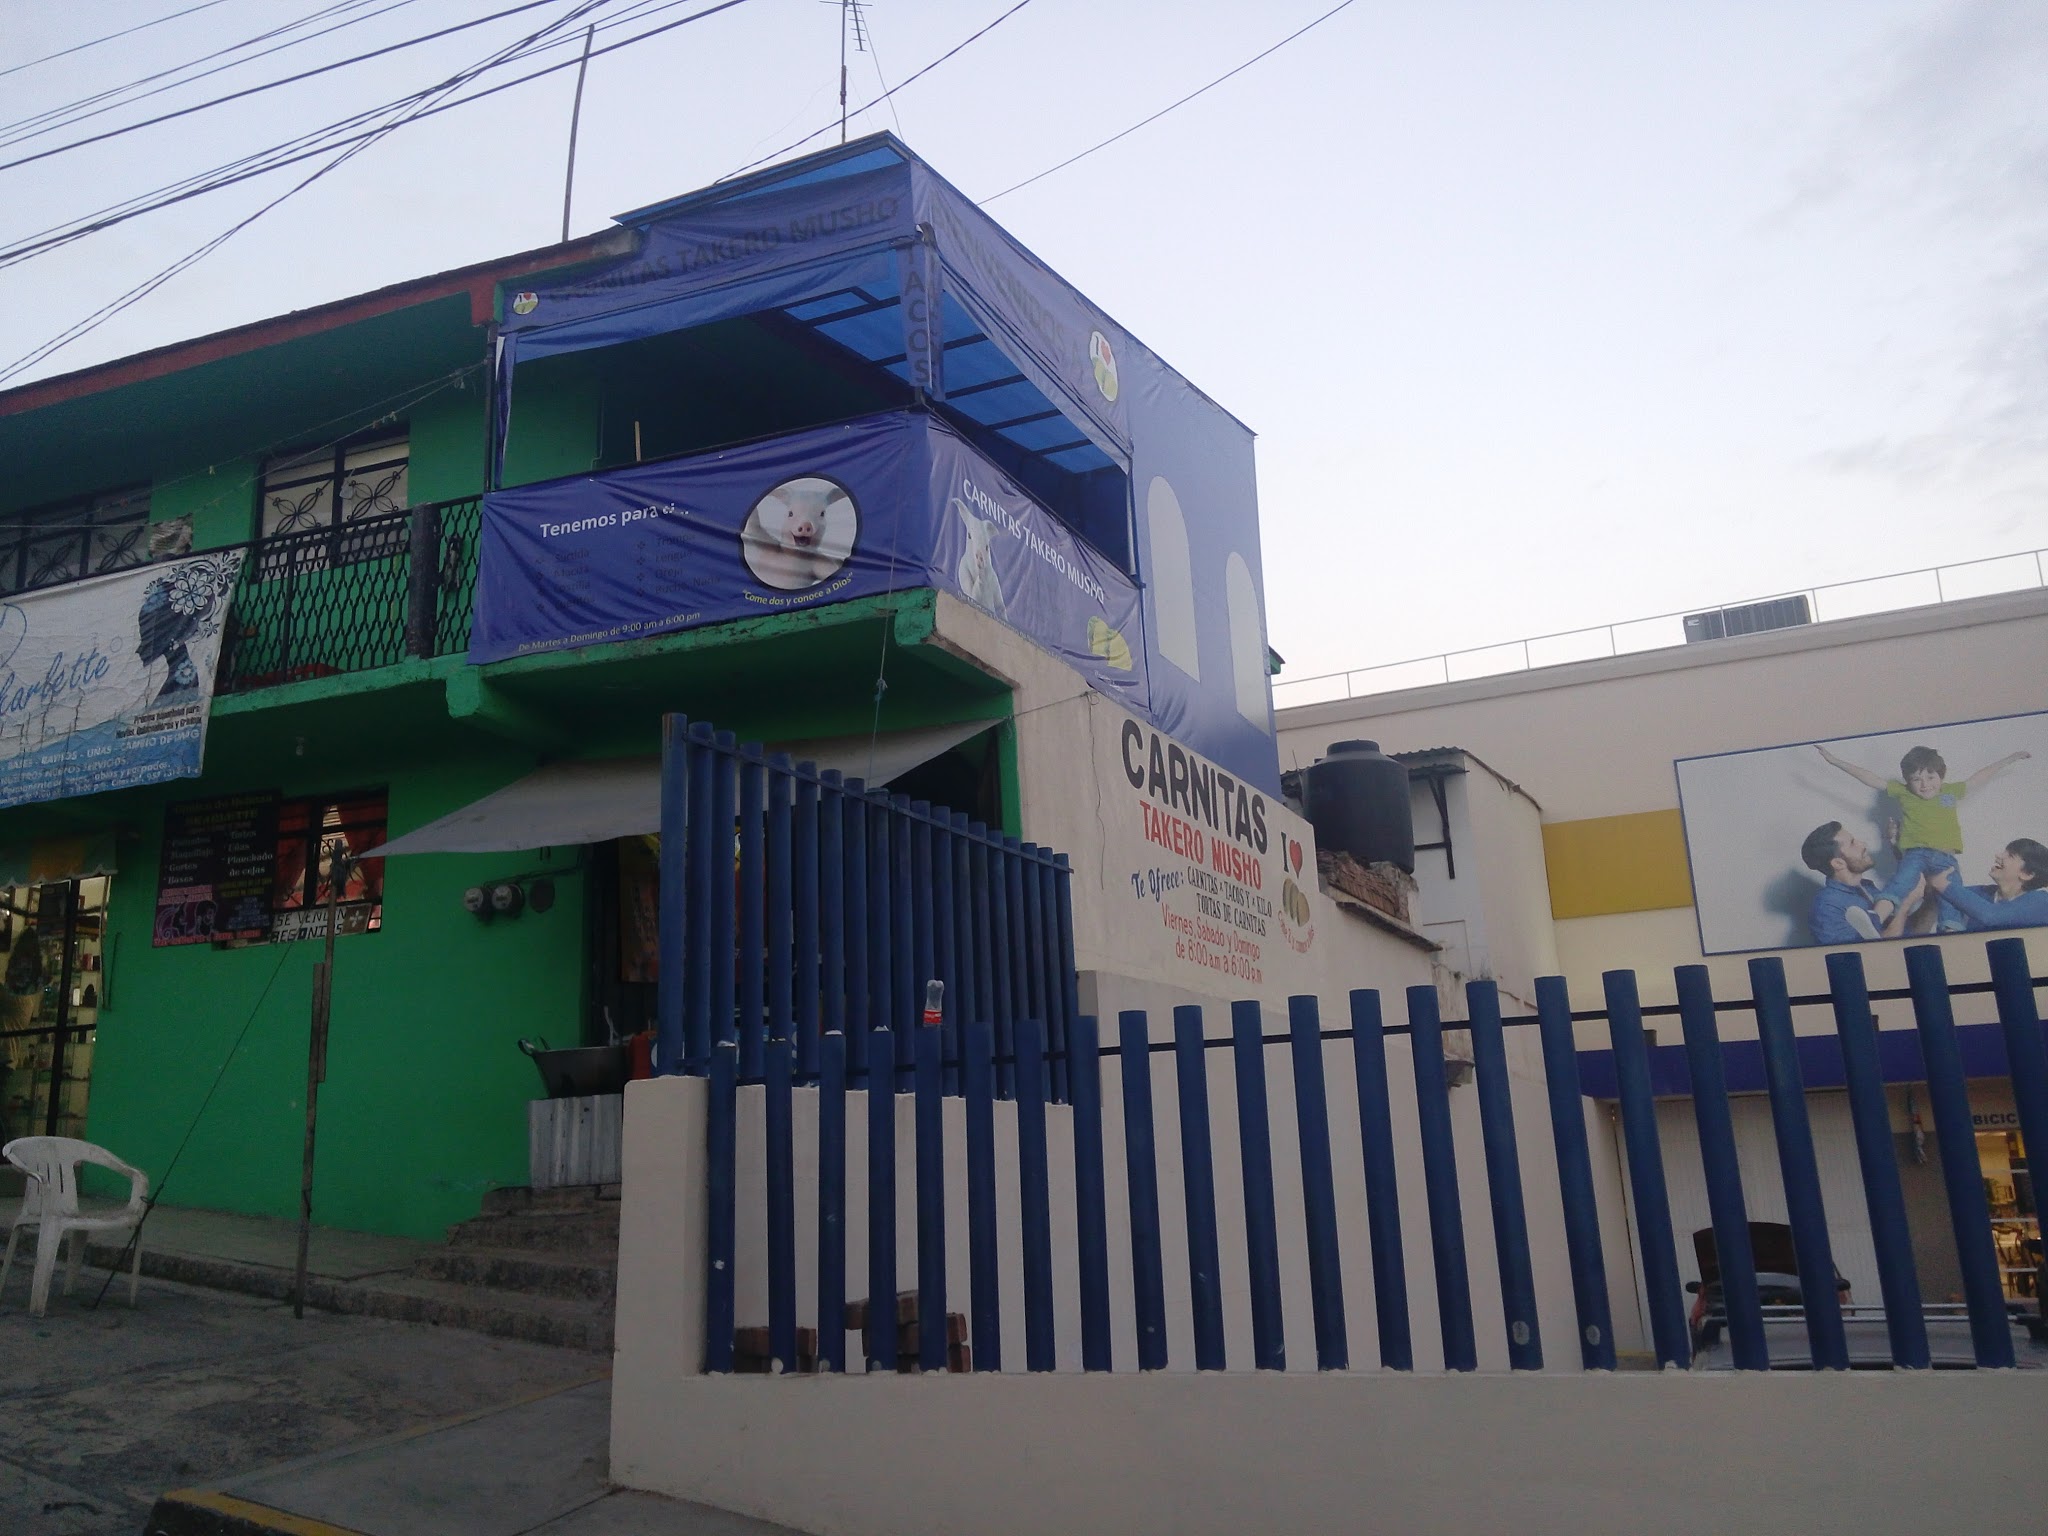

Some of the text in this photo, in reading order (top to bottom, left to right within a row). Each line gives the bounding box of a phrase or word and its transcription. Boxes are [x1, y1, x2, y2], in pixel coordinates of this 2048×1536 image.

[789, 196, 899, 243] MUSHO
[905, 246, 930, 383] TACOS
[540, 515, 616, 538] Tenemos
[621, 506, 658, 525] para
[963, 478, 1105, 604] CARNITAS TAKERO MUSHO
[769, 597, 784, 605] dos
[786, 598, 792, 606] y
[793, 590, 824, 603] conoce
[518, 643, 530, 652] De
[531, 638, 561, 650] Martes
[570, 631, 608, 643] Domingo
[610, 626, 621, 635] de
[622, 623, 642, 633] 9:00
[665, 615, 685, 625] 6:00
[686, 611, 700, 623] pm
[87, 745, 112, 758] UÑAS
[1122, 719, 1267, 854] CARNITAS
[227, 852, 273, 865] Planchado
[1140, 800, 1261, 890] TAKERO MUSHO
[1281, 832, 1289, 872] I
[229, 865, 266, 878] de cejas
[1131, 867, 1184, 903] Te Ofrece:
[1188, 866, 1218, 894] CARNITAS
[1224, 881, 1245, 906] TACOS
[1245, 891, 1250, 908] Y
[1256, 896, 1272, 917] KILO
[271, 923, 343, 942] BEGONIS
[277, 912, 292, 926] SE
[298, 908, 347, 924] VENN
[1196, 893, 1266, 936] TORTAS DE CARNITAS
[1175, 936, 1185, 959] de
[1188, 939, 1208, 966] 8:00
[1224, 956, 1229, 972] a
[1231, 955, 1250, 980] 6:00
[1197, 917, 1225, 946] Sabado
[1227, 934, 1232, 953] y
[1234, 930, 1260, 960] Domingo
